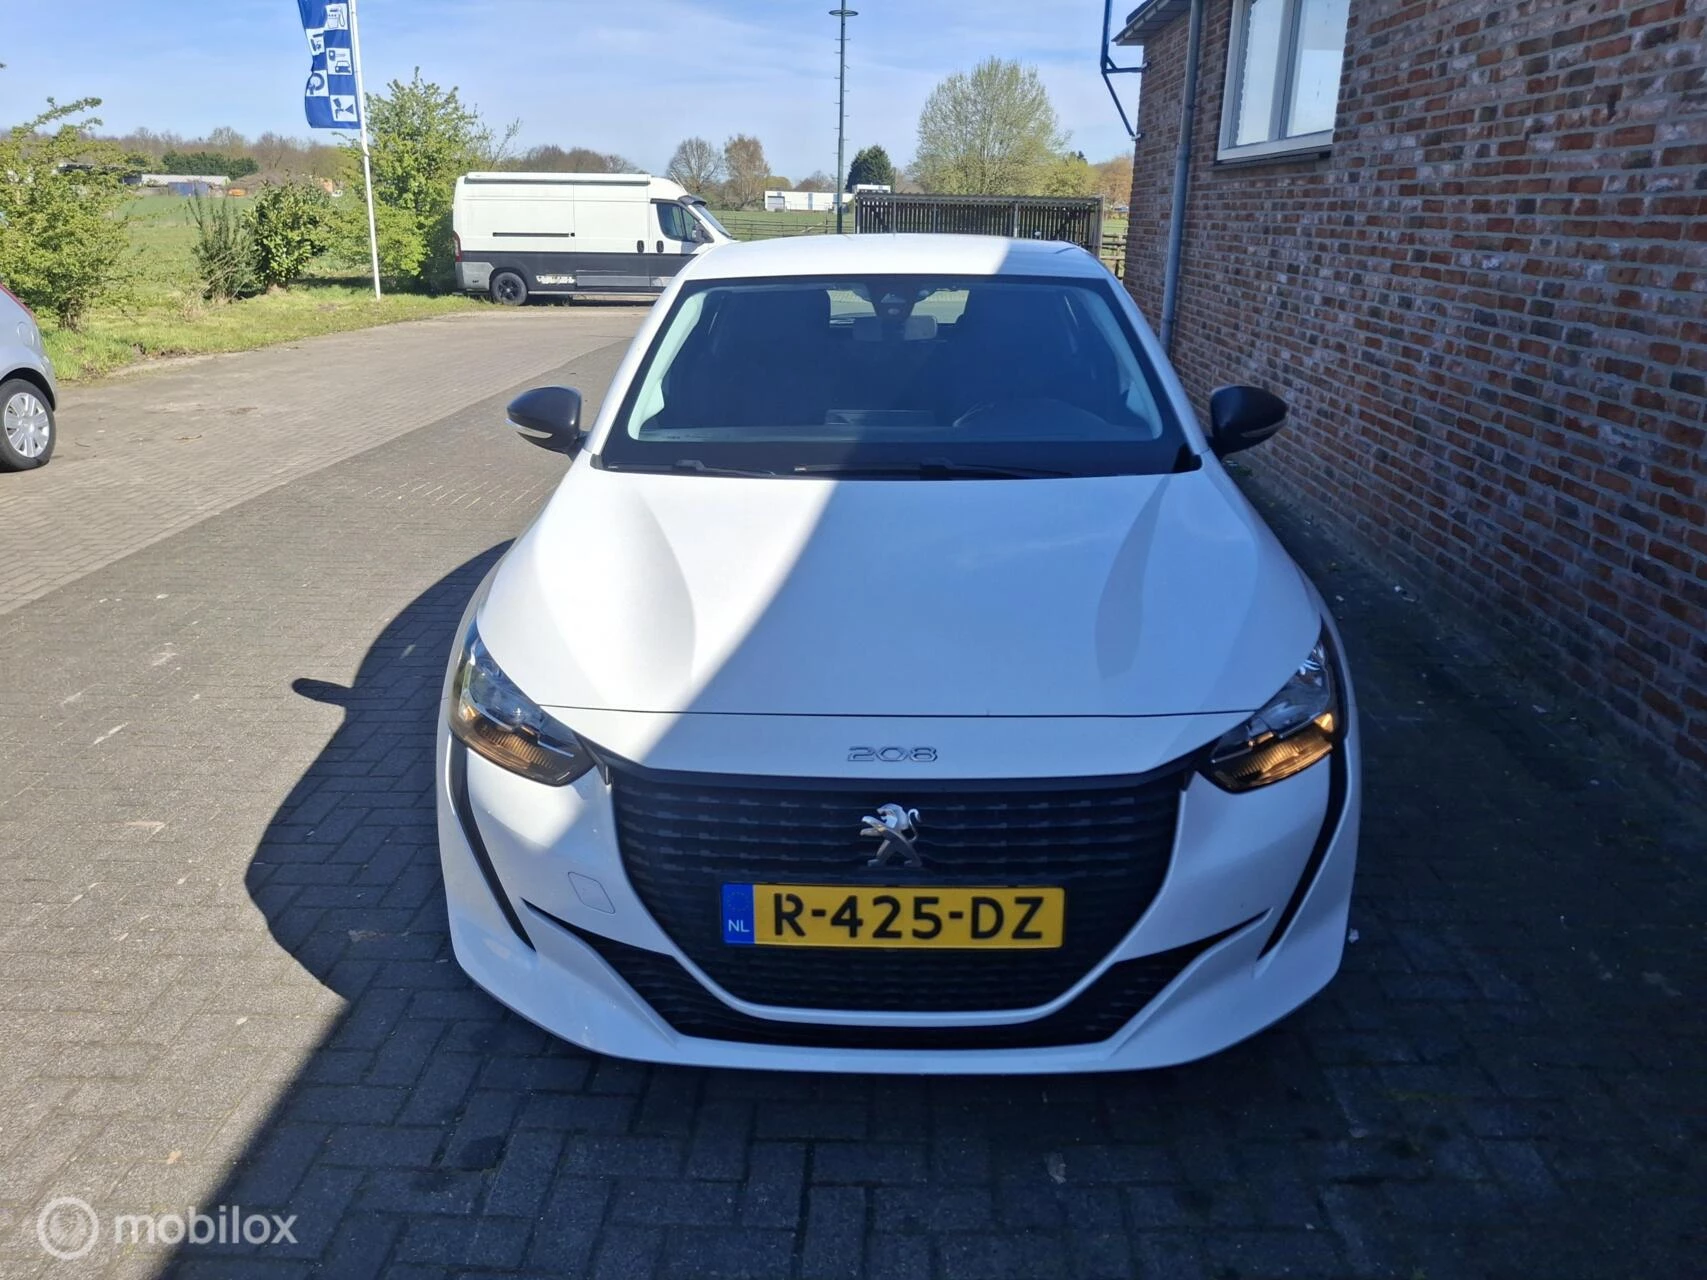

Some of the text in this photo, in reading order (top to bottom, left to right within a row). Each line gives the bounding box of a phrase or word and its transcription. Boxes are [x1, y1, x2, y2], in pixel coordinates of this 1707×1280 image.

[847, 746, 938, 762] 208
[773, 893, 1045, 940] R-425-DZ
[728, 920, 749, 933] NL
